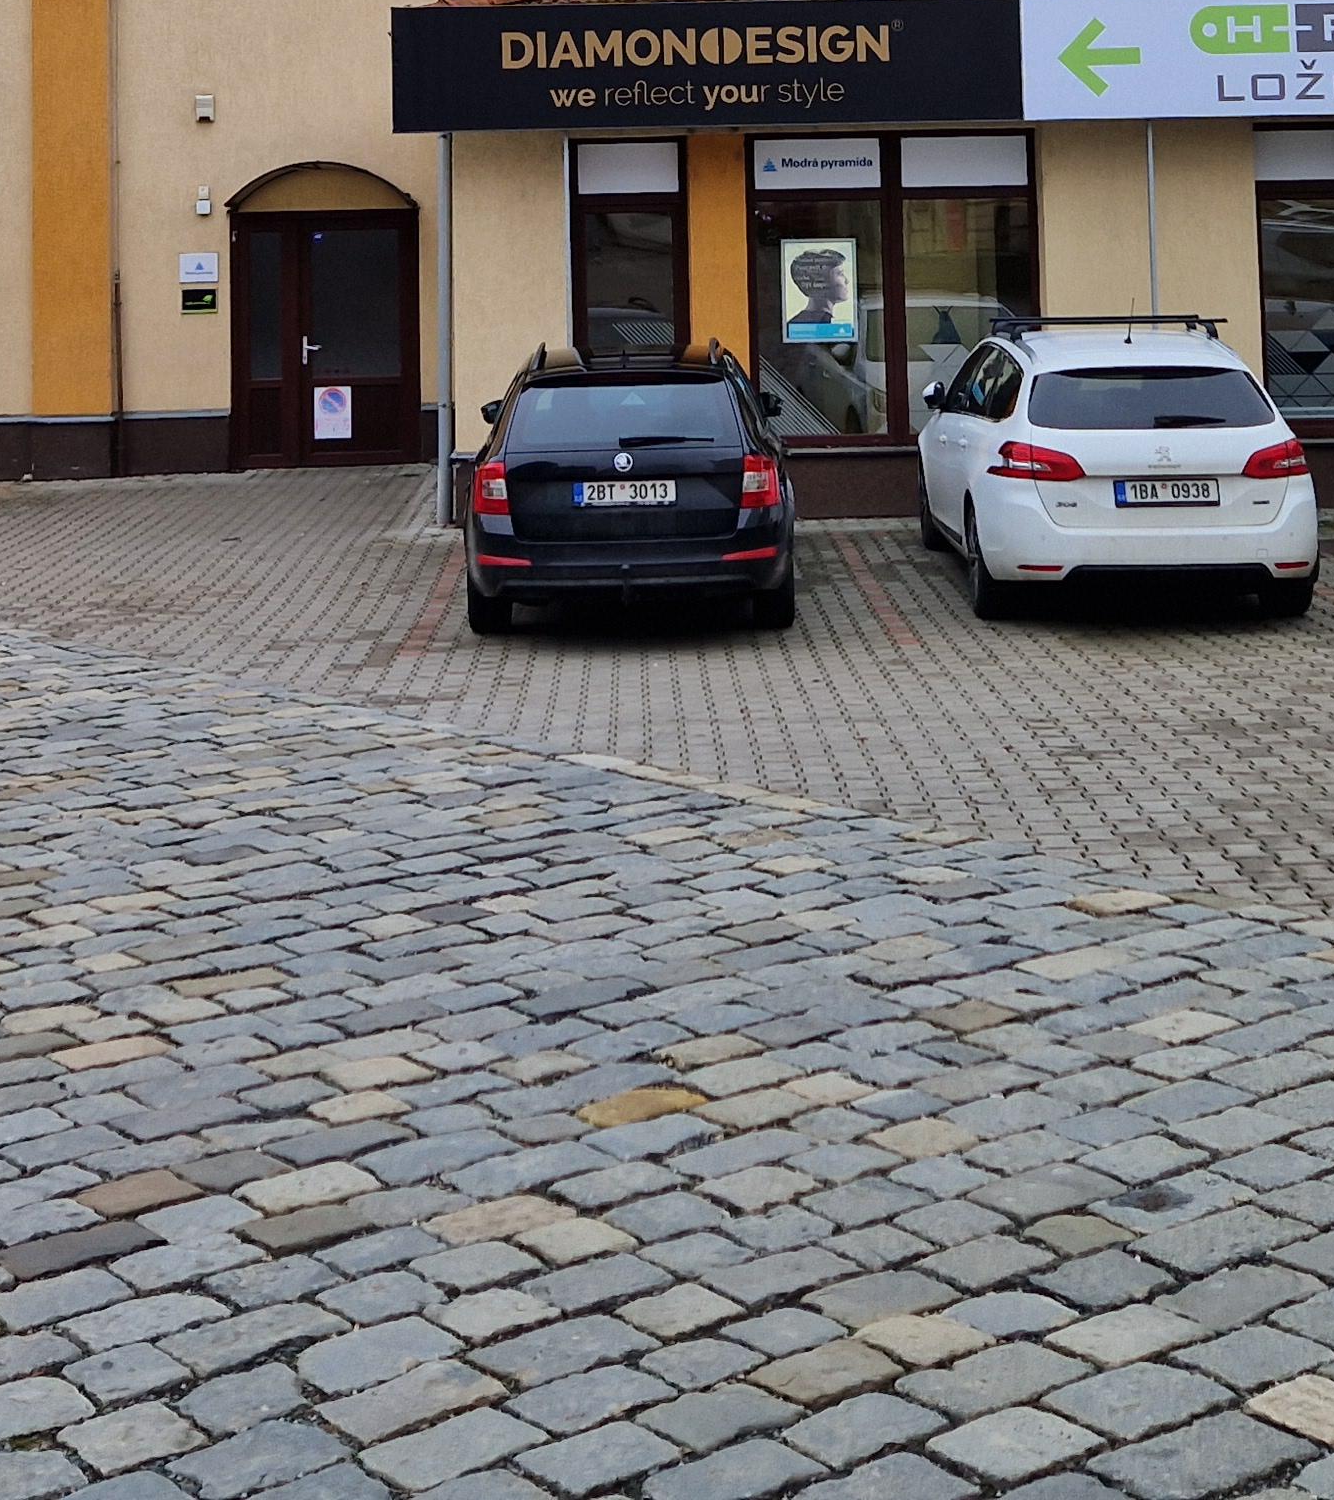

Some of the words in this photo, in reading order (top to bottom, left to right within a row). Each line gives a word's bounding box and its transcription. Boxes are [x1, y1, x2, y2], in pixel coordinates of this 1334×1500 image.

[549, 87, 596, 109] we
[604, 79, 696, 107] reflect
[702, 83, 770, 112] your
[778, 77, 845, 109] style
[781, 157, 819, 168] Modrá
[821, 157, 873, 170] pyramida
[587, 483, 616, 501] 2BT
[629, 483, 668, 500] 3013
[1130, 483, 1159, 500] 1BA
[1171, 483, 1210, 499] 0938
